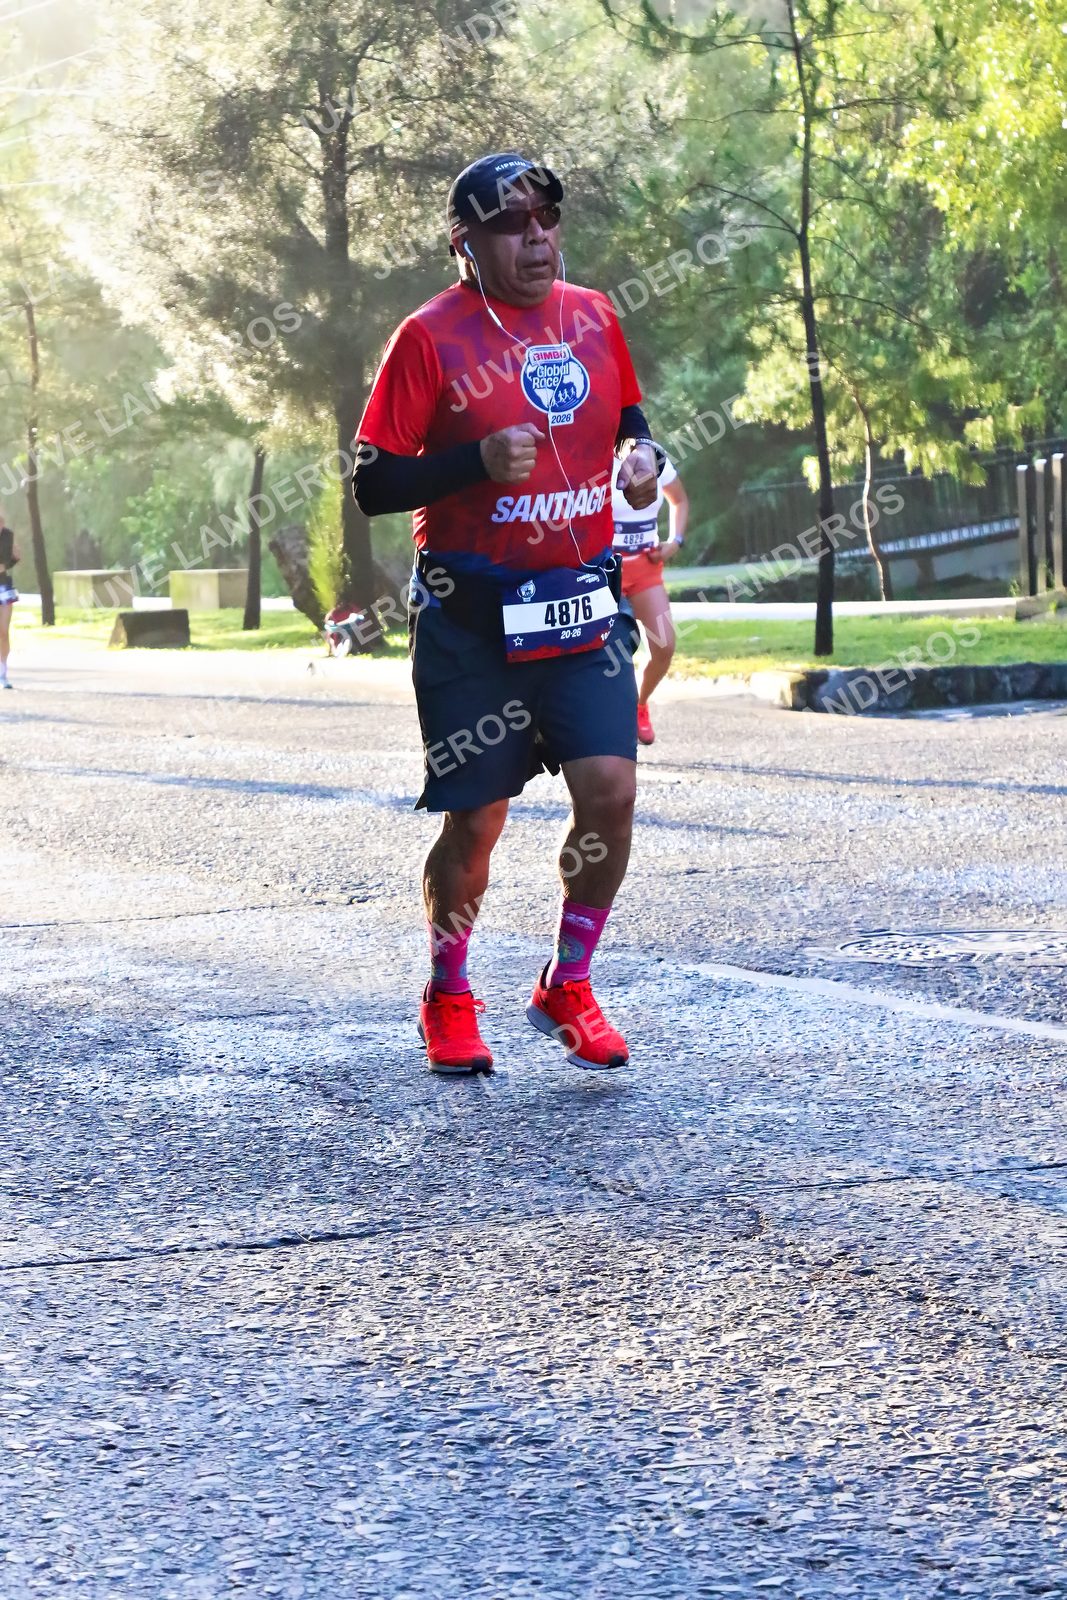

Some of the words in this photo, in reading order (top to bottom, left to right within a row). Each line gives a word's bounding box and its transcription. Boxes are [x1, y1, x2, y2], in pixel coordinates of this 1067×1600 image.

[536, 363, 570, 377] Global
[532, 376, 560, 389] Race
[491, 484, 606, 523] SANTIAGO
[544, 595, 593, 627] 4876
